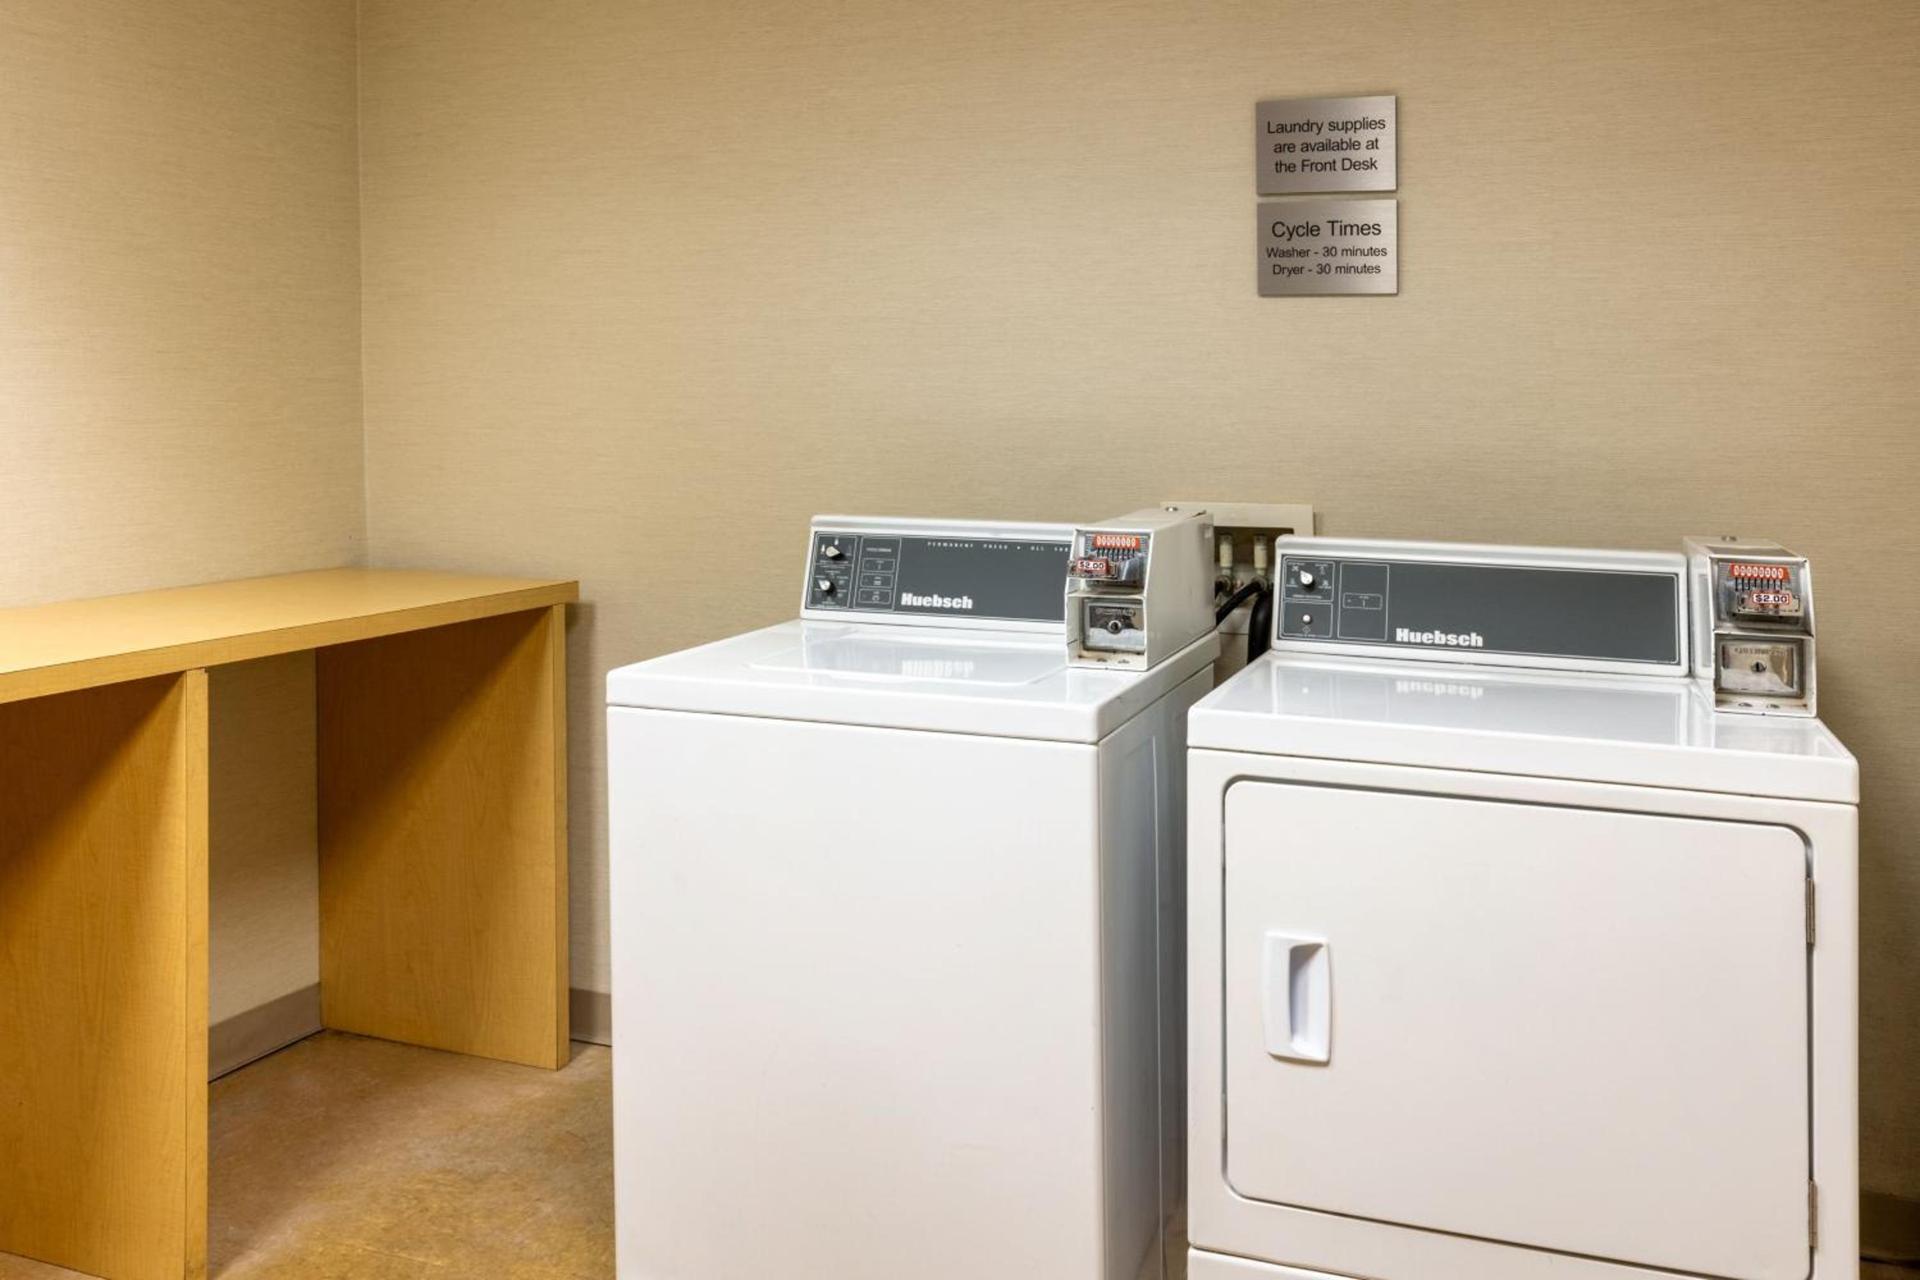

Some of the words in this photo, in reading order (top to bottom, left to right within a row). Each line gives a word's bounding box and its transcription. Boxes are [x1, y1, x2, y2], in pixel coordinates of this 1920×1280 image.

[1267, 119, 1323, 135] Laundry
[1328, 116, 1386, 133] supplies
[1273, 142, 1296, 153] are
[1300, 138, 1361, 152] available
[1365, 137, 1379, 150] at
[1275, 160, 1296, 173] the
[1301, 159, 1336, 172] Front
[1341, 157, 1378, 171] Desk
[1271, 221, 1321, 241] Cycle
[1326, 220, 1382, 237] Times
[1266, 247, 1310, 258] Washer
[1322, 246, 1337, 257] 30
[1341, 246, 1388, 257] minutes
[1272, 264, 1304, 277] Dryer
[1316, 264, 1331, 275] 30
[1335, 263, 1381, 275] minutes
[901, 592, 973, 609] Huebsch
[1755, 594, 1788, 603] $2.00
[1396, 627, 1483, 647] Huebsch
